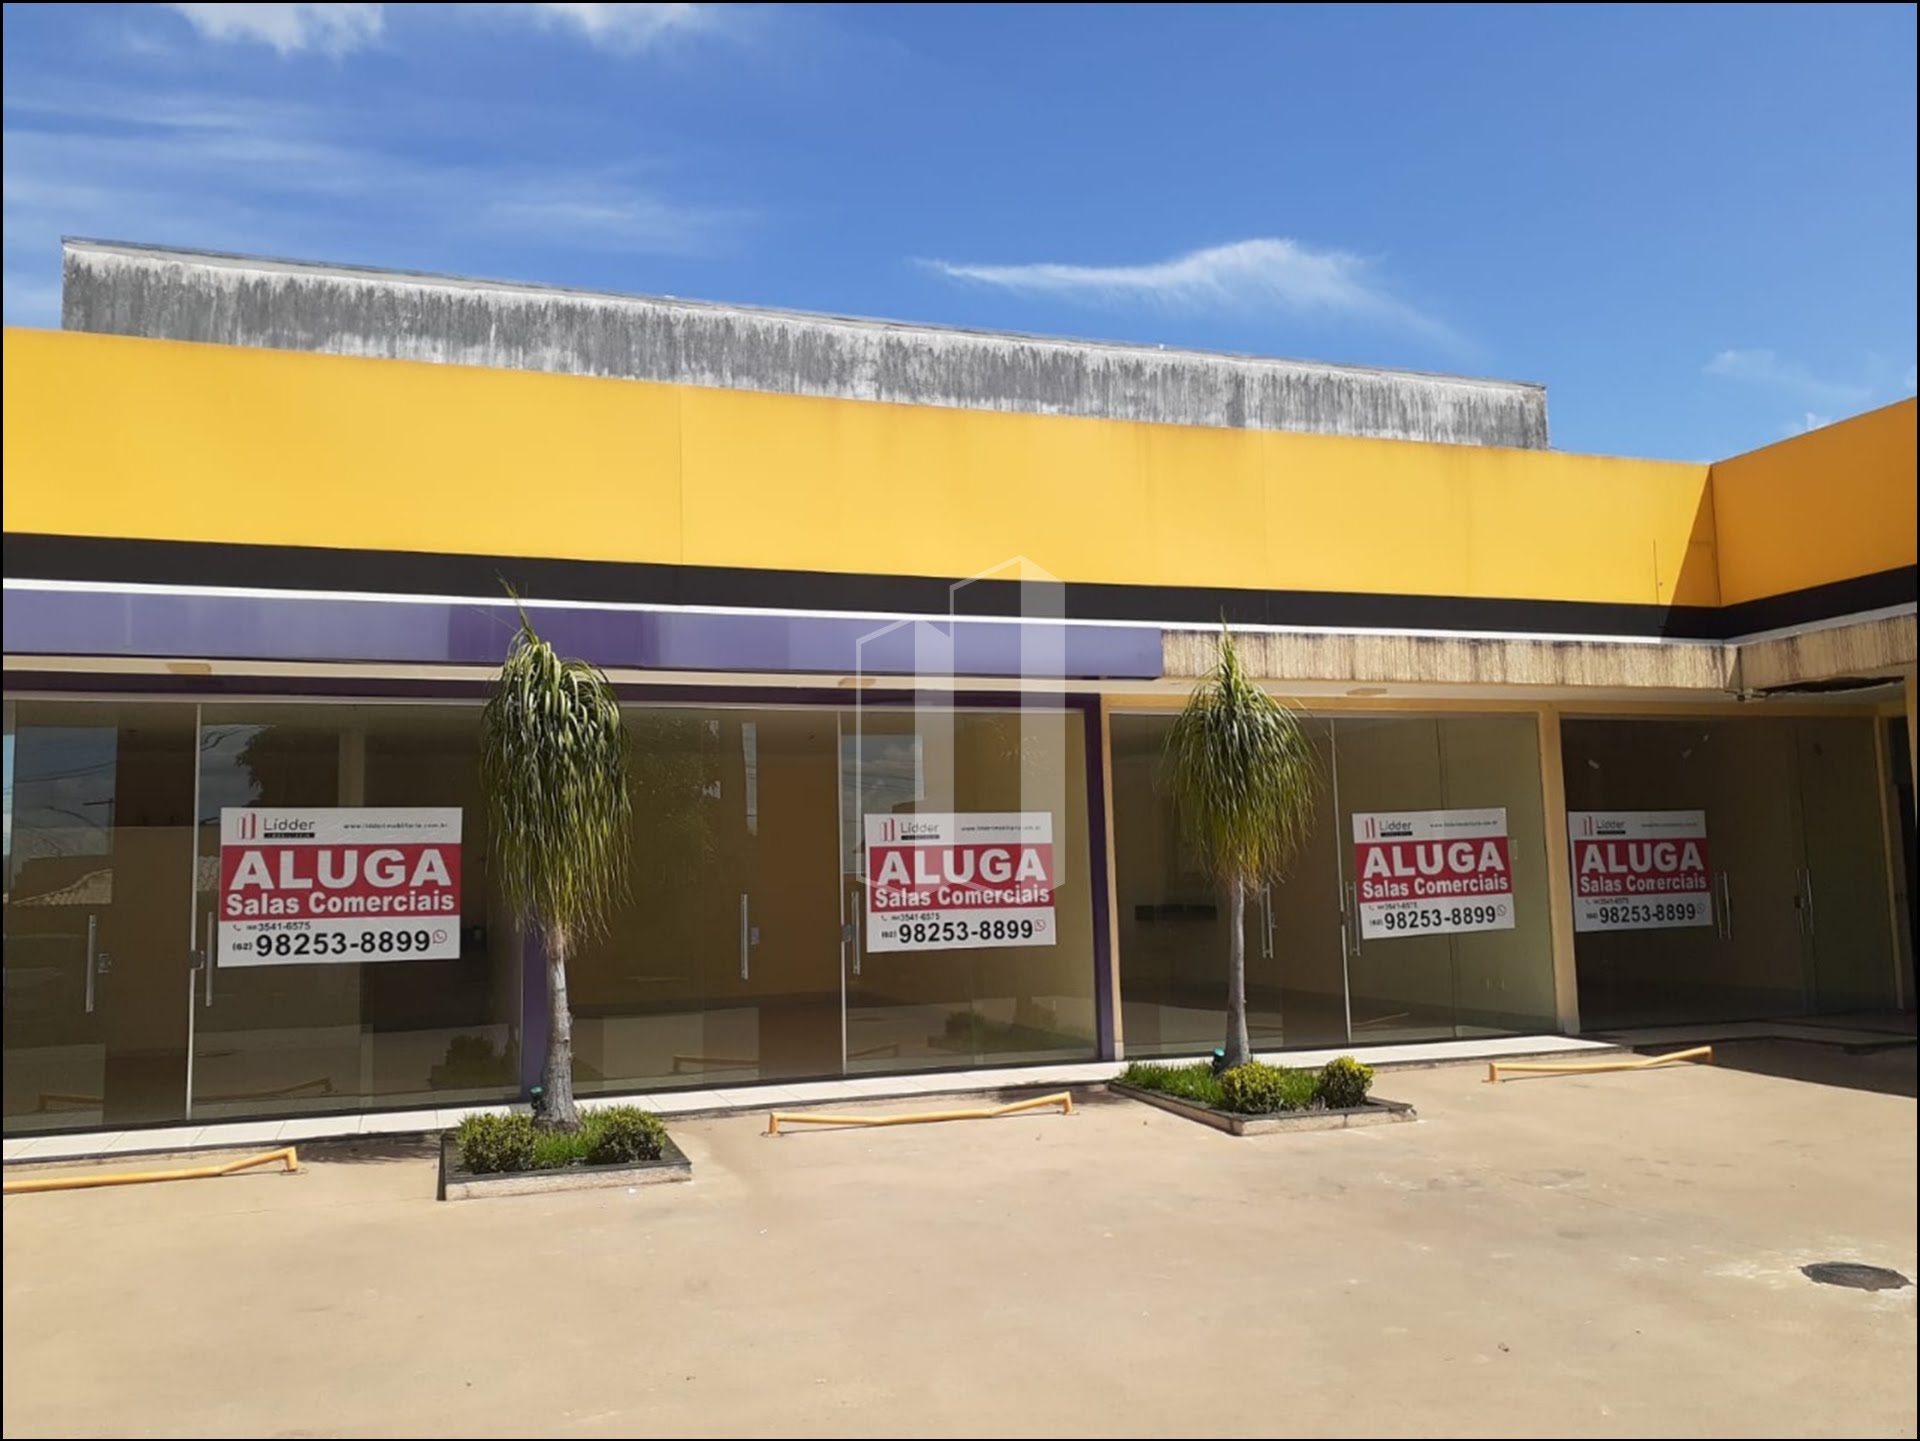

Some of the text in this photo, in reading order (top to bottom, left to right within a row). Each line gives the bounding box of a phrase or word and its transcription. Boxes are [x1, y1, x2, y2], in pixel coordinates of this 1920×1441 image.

[229, 849, 452, 891] ALUGA
[877, 848, 1047, 886] ALUGA
[1363, 841, 1505, 879] ALUGA
[1581, 842, 1705, 874] ALUGA
[1362, 873, 1509, 899] Salas Comerciais
[1580, 872, 1708, 893] Salas Comerciais
[226, 890, 455, 916] Salas Comerciais
[875, 885, 1050, 909] Salas Comerciais
[1384, 905, 1496, 930] 98253-8899
[1598, 903, 1696, 924] 98253-8899
[232, 930, 430, 957] (62) 98253-8899
[899, 919, 1034, 944] 98253-8899
